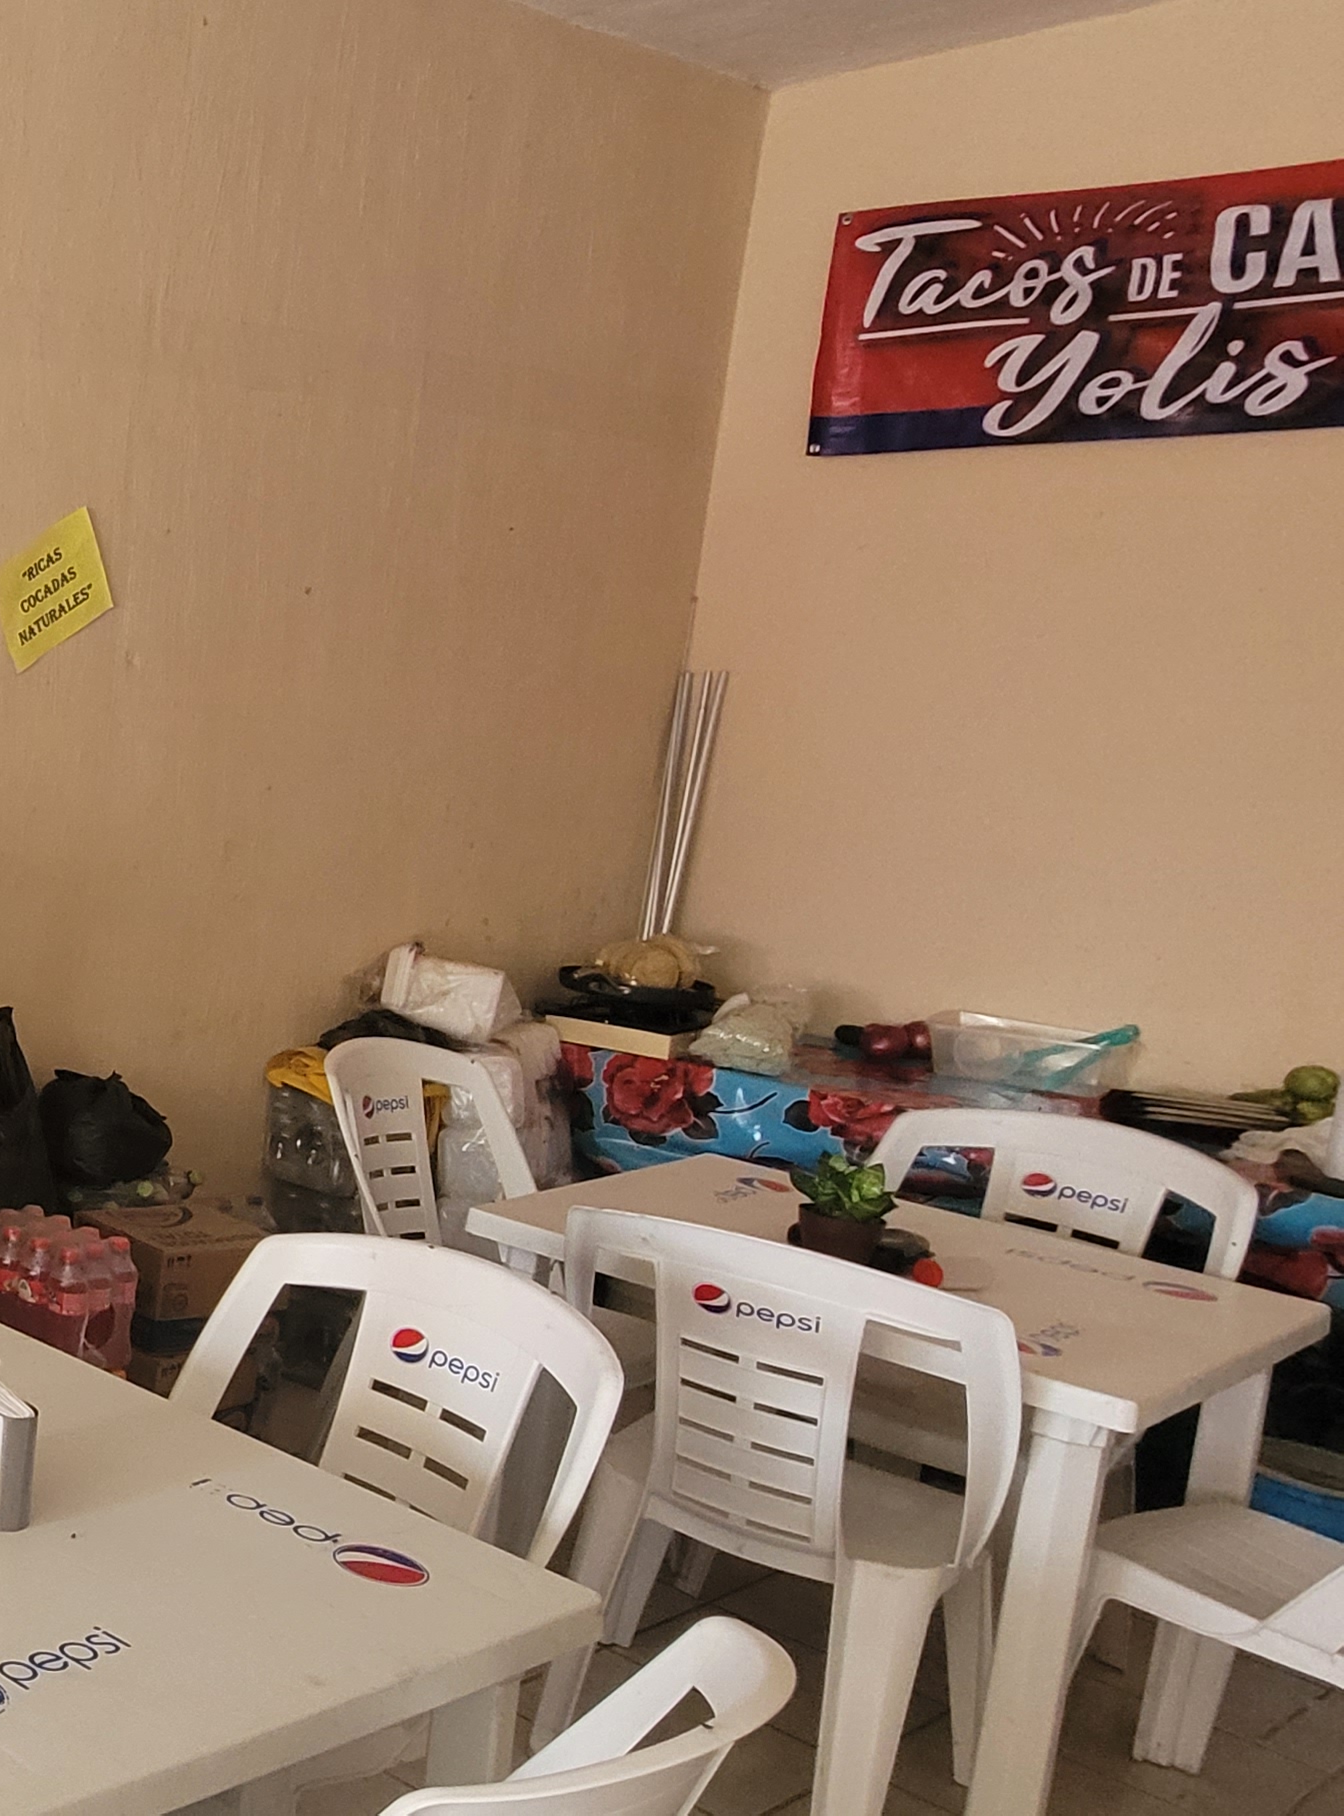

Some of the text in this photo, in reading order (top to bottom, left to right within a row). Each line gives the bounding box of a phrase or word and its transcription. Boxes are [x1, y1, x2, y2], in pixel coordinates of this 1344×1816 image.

[855, 218, 1115, 326] Tacos
[1127, 253, 1183, 302] DE
[983, 302, 1337, 437] Yolis
[20, 566, 77, 614] COCADAS
[376, 1096, 410, 1114] pepsi
[1058, 1184, 1129, 1214] pepsi
[735, 1301, 822, 1334] pepsi
[428, 1350, 500, 1393] pepsi
